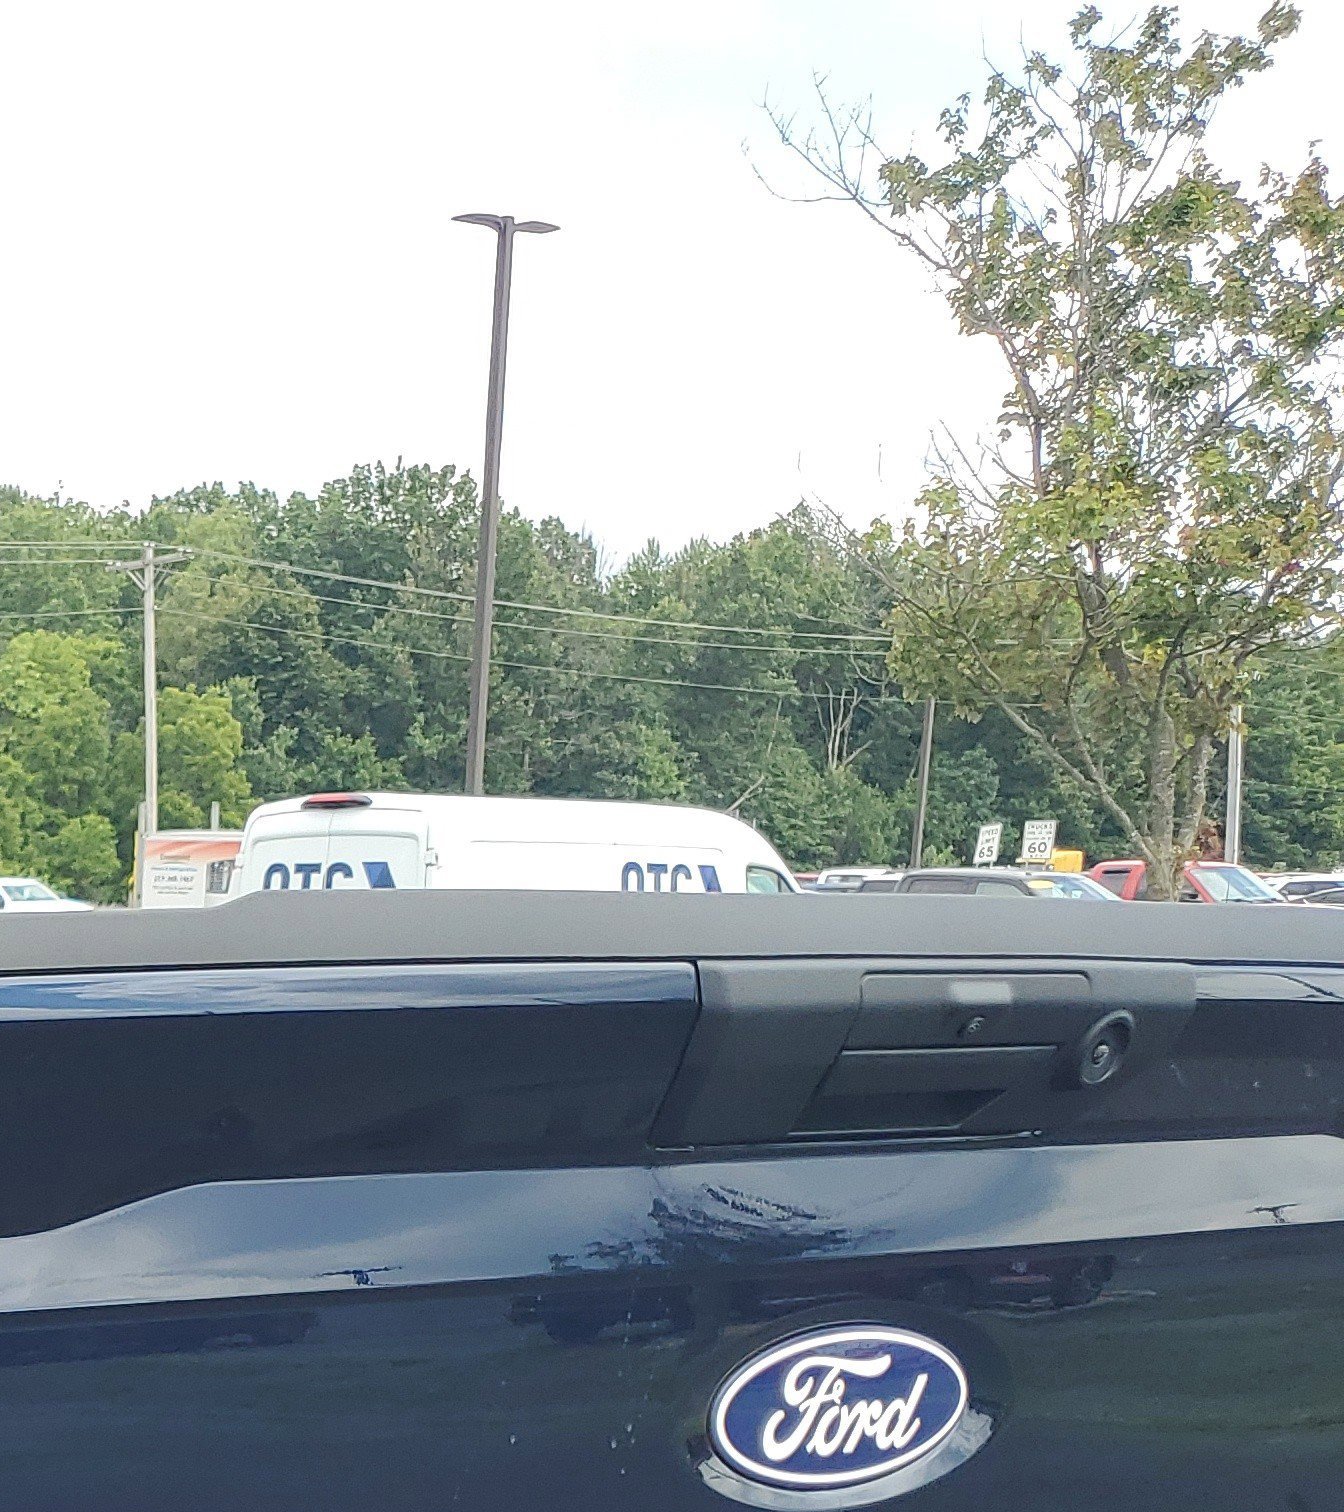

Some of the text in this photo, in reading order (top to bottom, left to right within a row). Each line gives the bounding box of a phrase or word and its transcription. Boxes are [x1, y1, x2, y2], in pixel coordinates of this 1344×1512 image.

[978, 845, 994, 858] 65
[1027, 841, 1047, 854] 60
[762, 1353, 929, 1462] Ford
